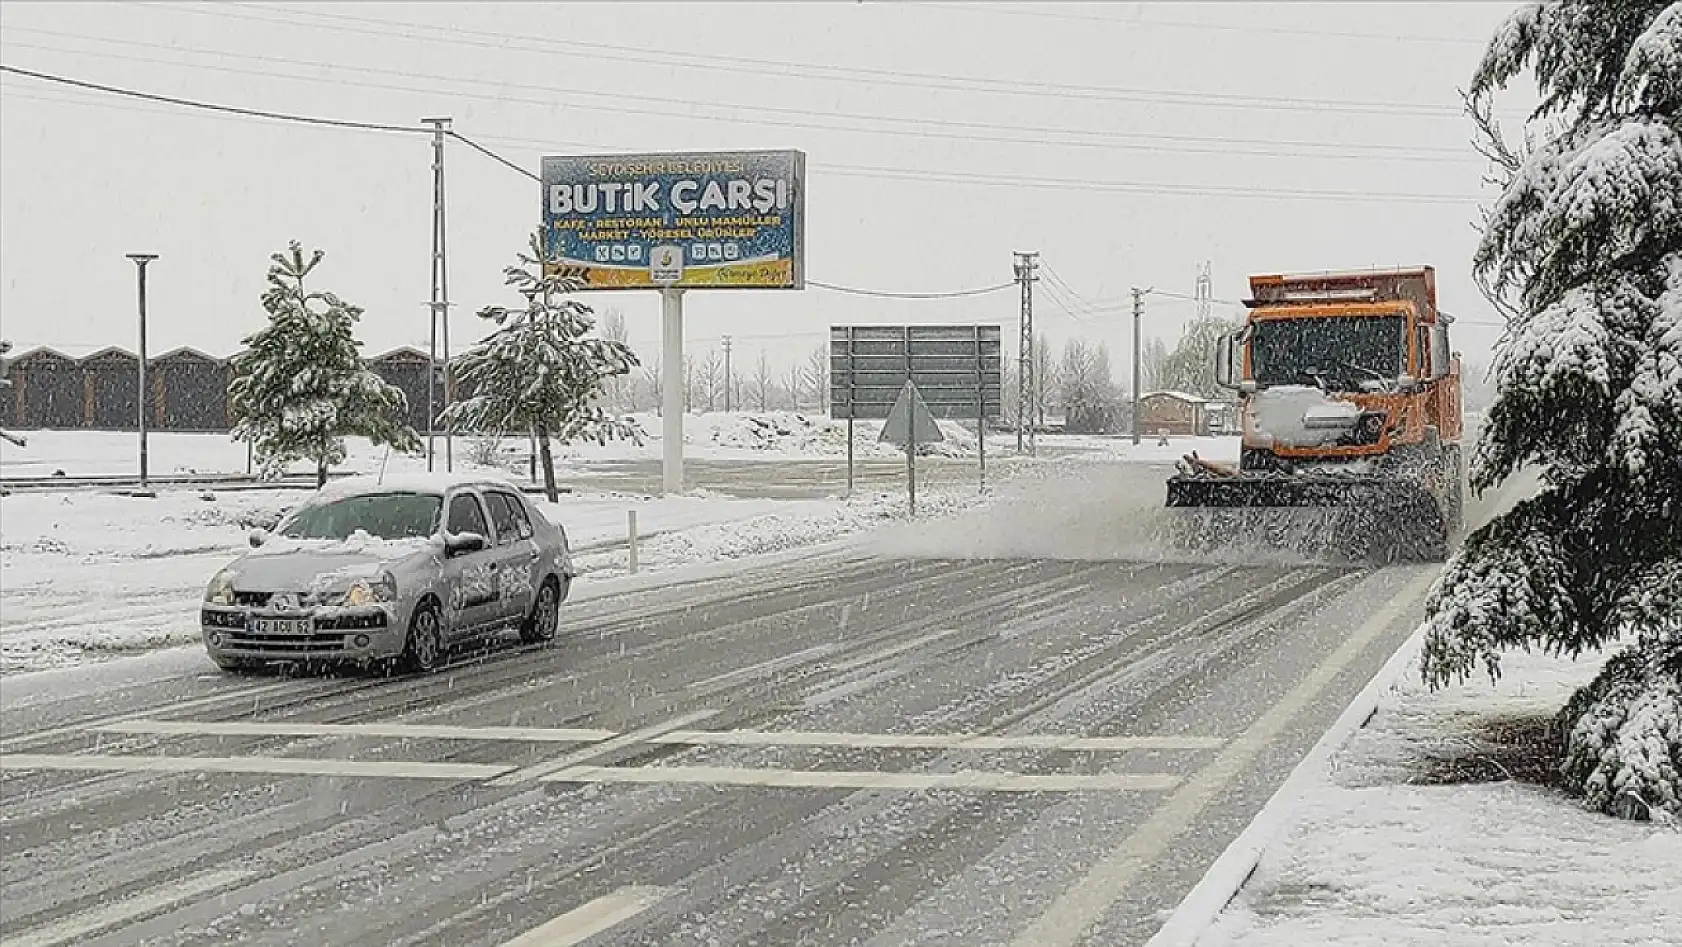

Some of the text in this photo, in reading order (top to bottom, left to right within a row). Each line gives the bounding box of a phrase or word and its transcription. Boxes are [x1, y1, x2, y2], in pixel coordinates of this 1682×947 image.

[671, 179, 787, 214] ÇARŞI
[554, 218, 586, 229] KAFE
[596, 217, 662, 229] RESTORAN
[579, 230, 629, 241] MARKET
